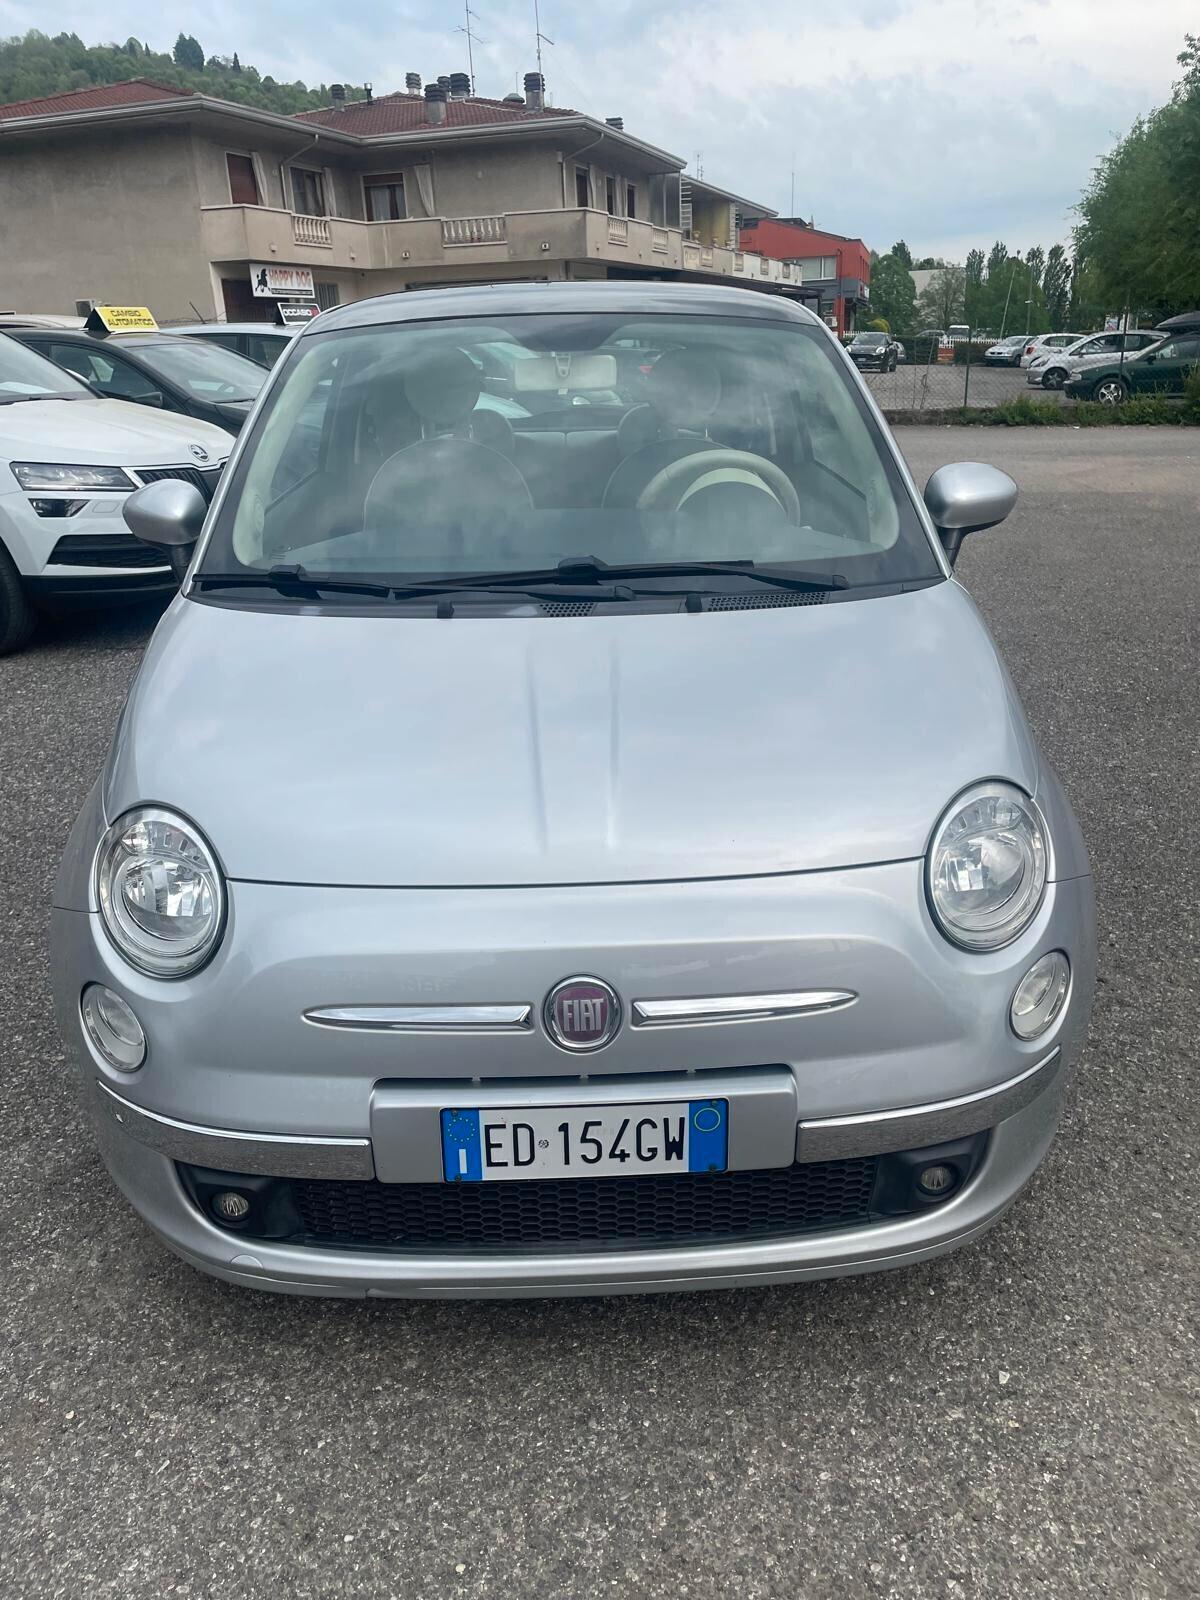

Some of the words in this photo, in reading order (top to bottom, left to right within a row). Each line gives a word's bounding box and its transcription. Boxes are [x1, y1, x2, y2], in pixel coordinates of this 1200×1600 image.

[562, 998, 604, 1031] FIAT
[484, 1122, 536, 1167] ED
[558, 1116, 686, 1166] 154GW
